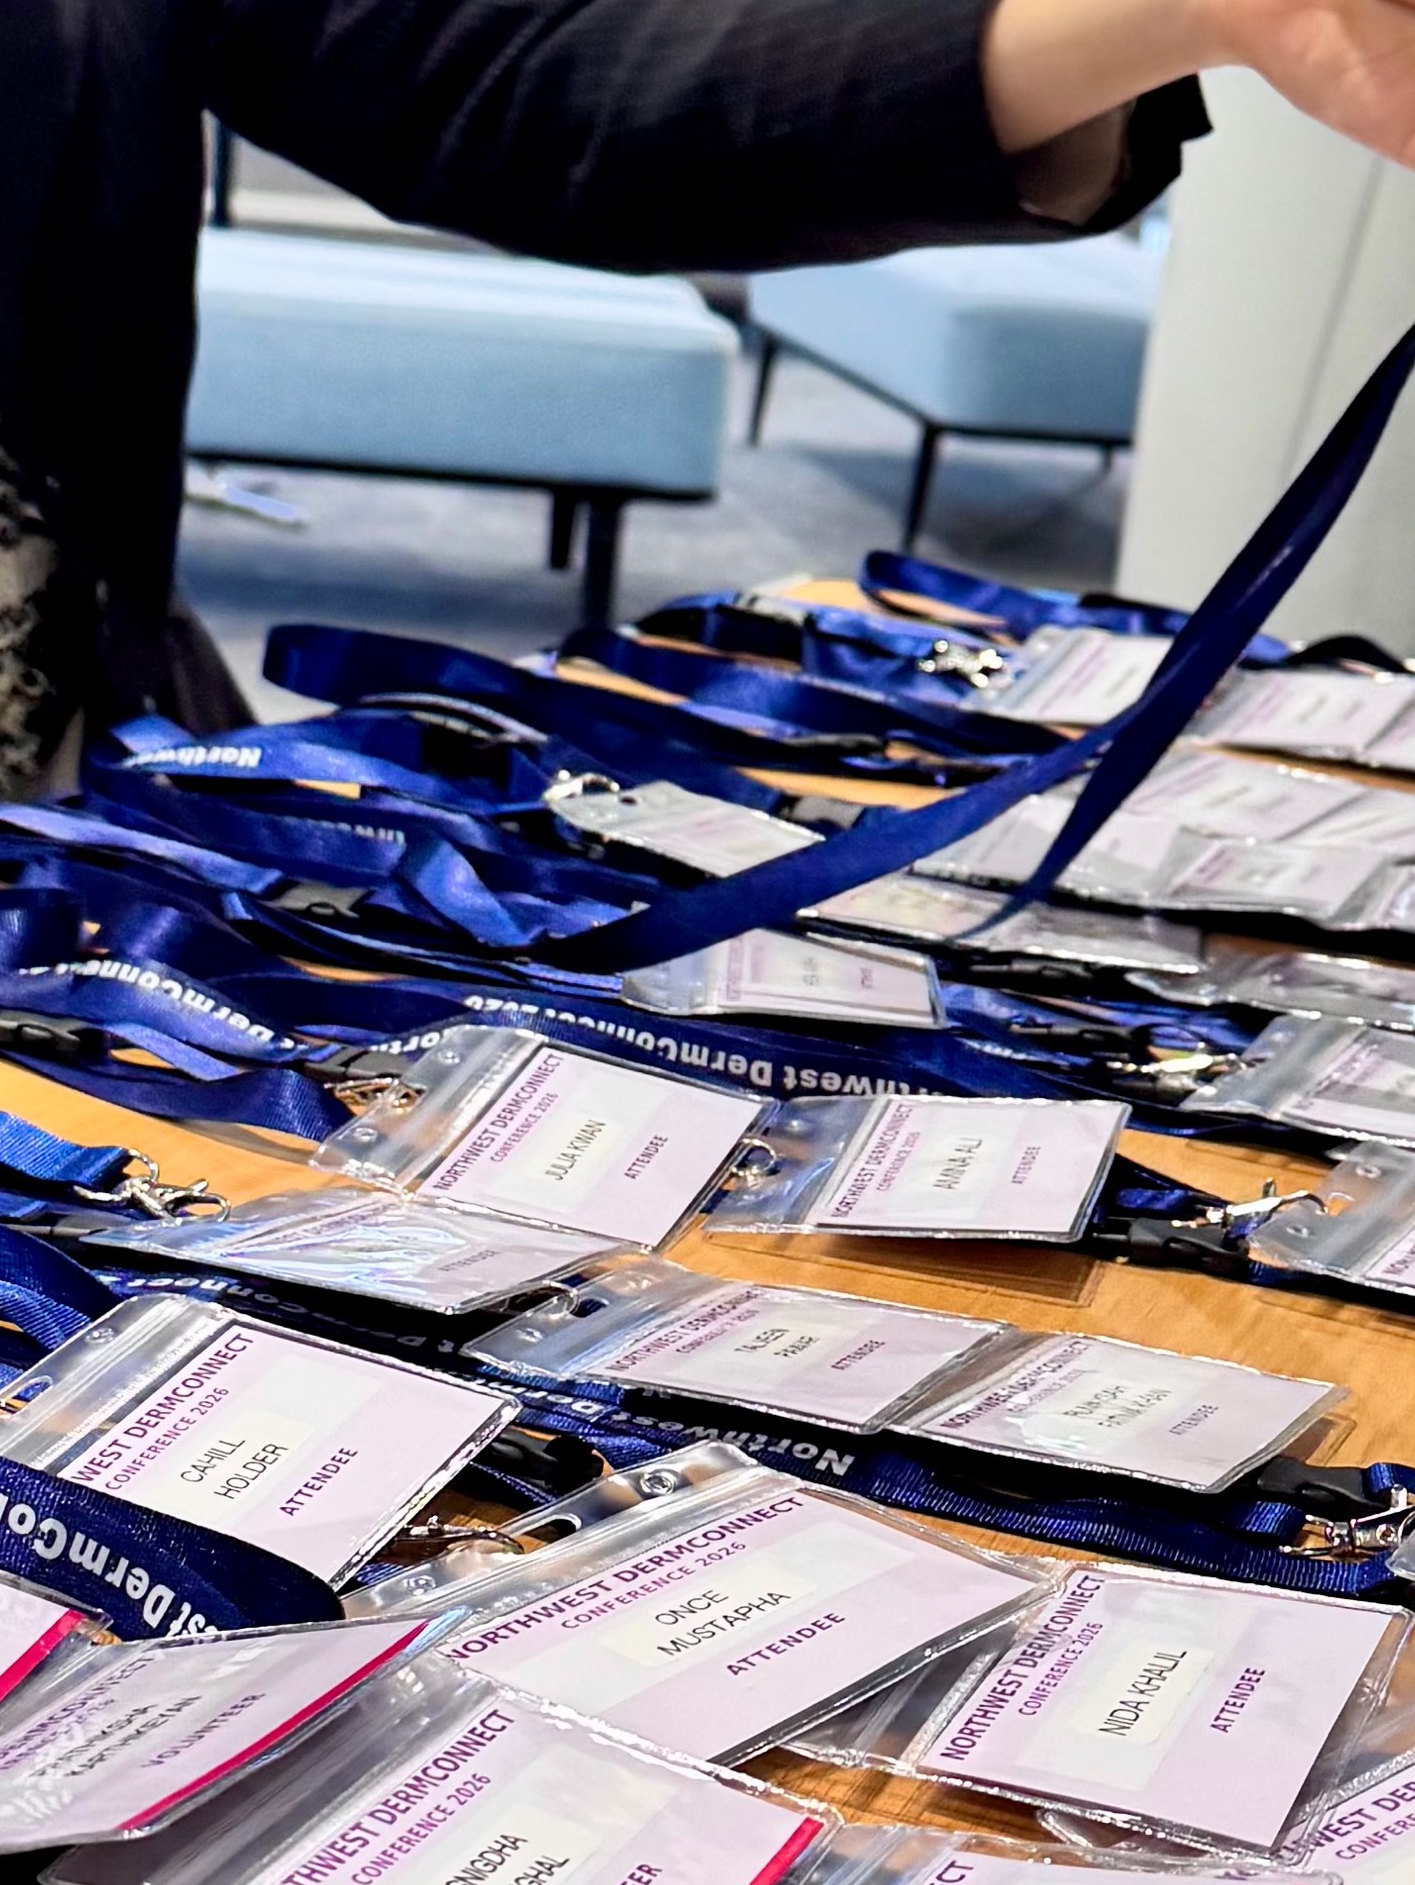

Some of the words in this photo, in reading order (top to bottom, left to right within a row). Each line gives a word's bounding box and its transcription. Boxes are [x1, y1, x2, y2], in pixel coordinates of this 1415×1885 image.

[433, 1117, 506, 1192] NORTHWEST
[494, 1053, 564, 1135] DERMCONNECT
[490, 1113, 540, 1163] CONFERENCE
[537, 1092, 558, 1118] 2026
[548, 1144, 586, 1181] JULIA
[572, 1119, 607, 1159] KWAN
[625, 1134, 668, 1180] ATTENDEE
[832, 1163, 878, 1219] NORTHWEST
[867, 1103, 911, 1169] DERMCONNECT
[878, 1155, 909, 1190] CONFERENCE
[907, 1130, 922, 1153] 2026
[933, 1158, 967, 1190] AMINA
[963, 1138, 982, 1163] ALI
[1011, 1145, 1041, 1185] ATTENDEE
[139, 1333, 255, 1436] DERMCONNECT
[105, 1414, 198, 1491] CONFERENCE
[197, 1387, 230, 1420] 2026
[180, 1439, 245, 1484] CAHILL
[215, 1443, 289, 1500] HOLDER
[611, 1408, 856, 1477] Northwest
[278, 1446, 358, 1517] ATTENDEE
[445, 1579, 613, 1664] NORTHWEST
[609, 1497, 804, 1598] DERMCONNECT
[560, 1562, 697, 1630] CONFERENCE
[694, 1540, 746, 1571] 2026
[654, 1589, 729, 1626] ONCE
[657, 1591, 792, 1657] MUSTAPHA
[724, 1612, 845, 1677] ATTENDEE
[940, 1670, 1030, 1762] NORTHWEST
[1022, 1575, 1107, 1673] DERMCONNECT
[1018, 1648, 1082, 1716] CONFERENCE
[1075, 1622, 1104, 1657] 2026
[1098, 1703, 1134, 1737] NIDA
[1129, 1650, 1187, 1705] KHALIL
[1211, 1667, 1266, 1734] ATTENDEE
[142, 1692, 267, 1769] VOLUNTEER
[369, 1709, 515, 1826] DERMCONNECT
[352, 1805, 454, 1885] CONFERENCE
[446, 1773, 492, 1808] 2026
